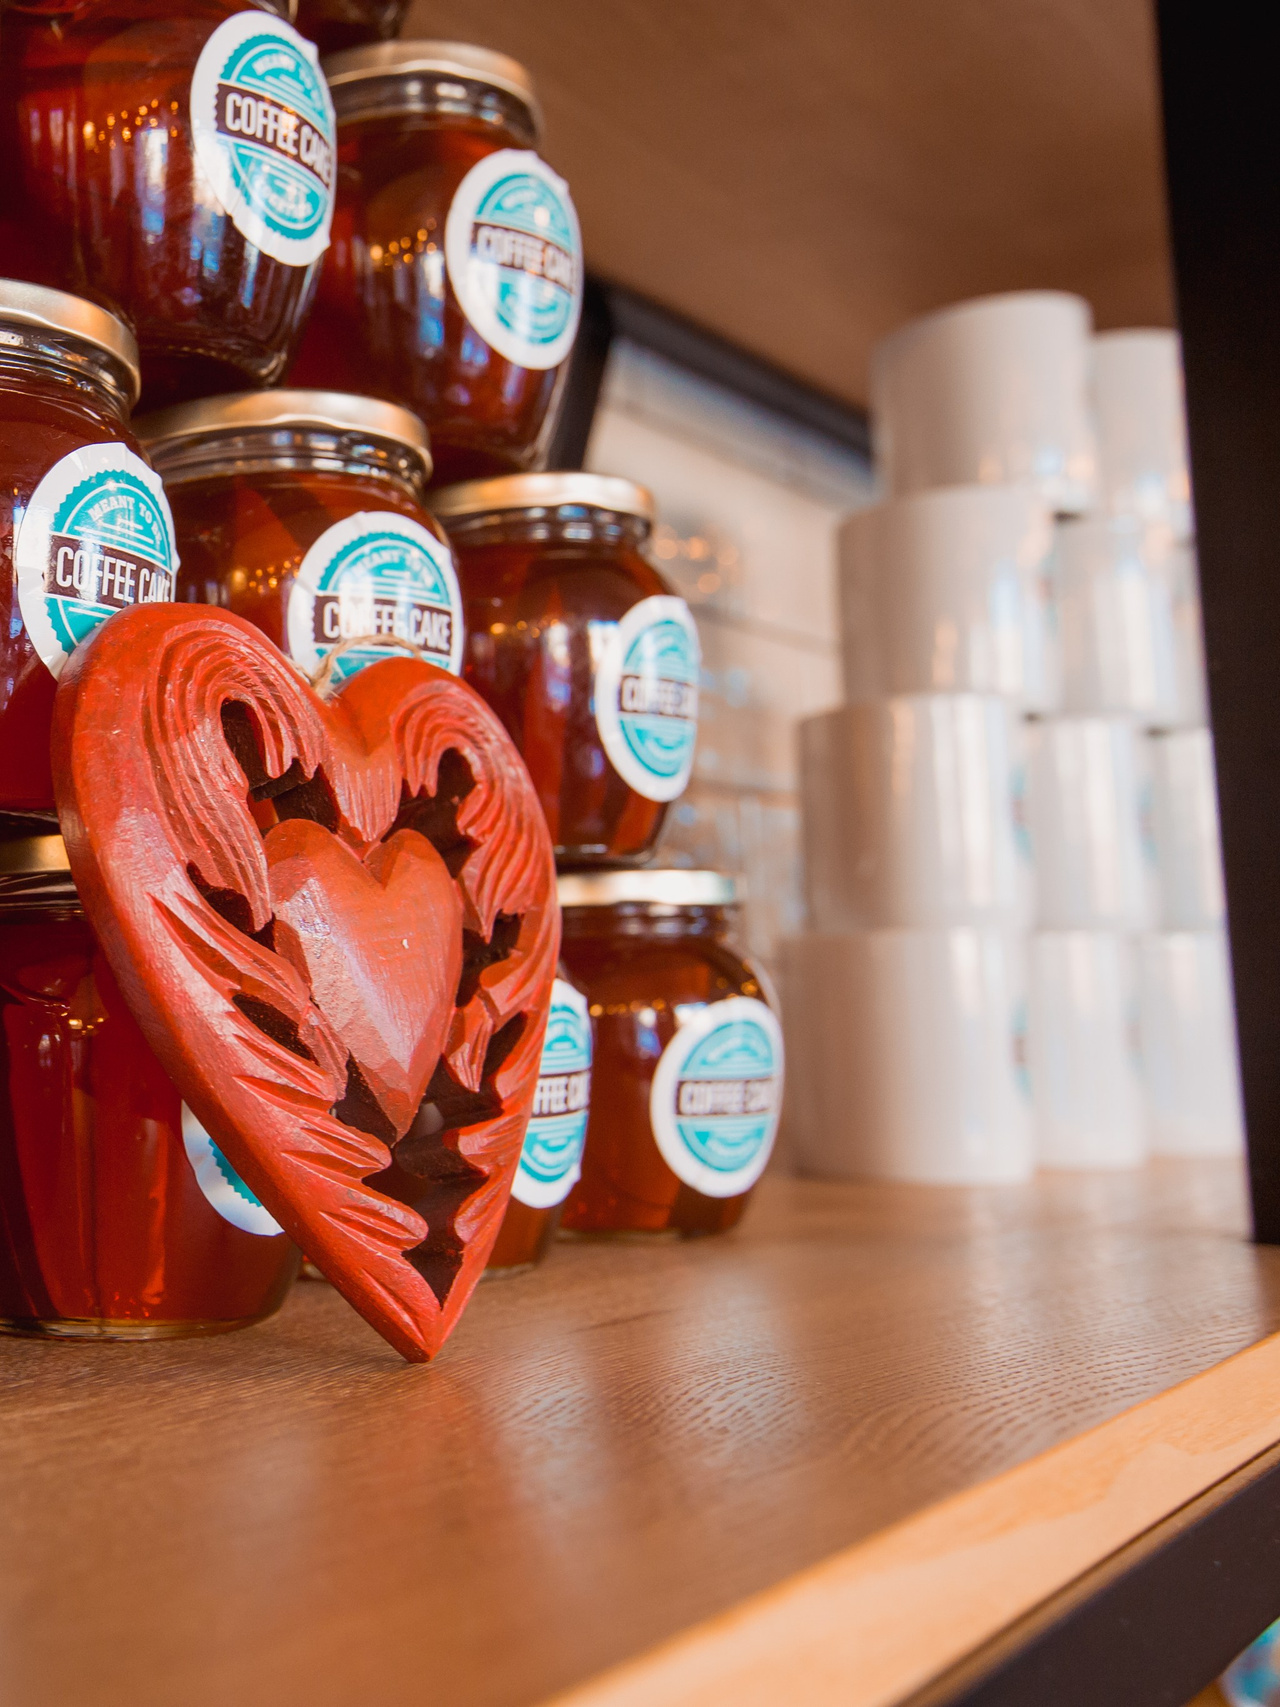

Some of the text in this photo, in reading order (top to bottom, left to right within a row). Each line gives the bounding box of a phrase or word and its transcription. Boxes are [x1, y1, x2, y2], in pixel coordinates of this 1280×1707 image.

[225, 92, 299, 155] COFFEE
[87, 495, 135, 521] MEANT
[139, 502, 153, 524] TO
[56, 546, 171, 604] COFFEE CAKE
[409, 607, 451, 651] CAKE
[532, 1076, 568, 1115] FFEE
